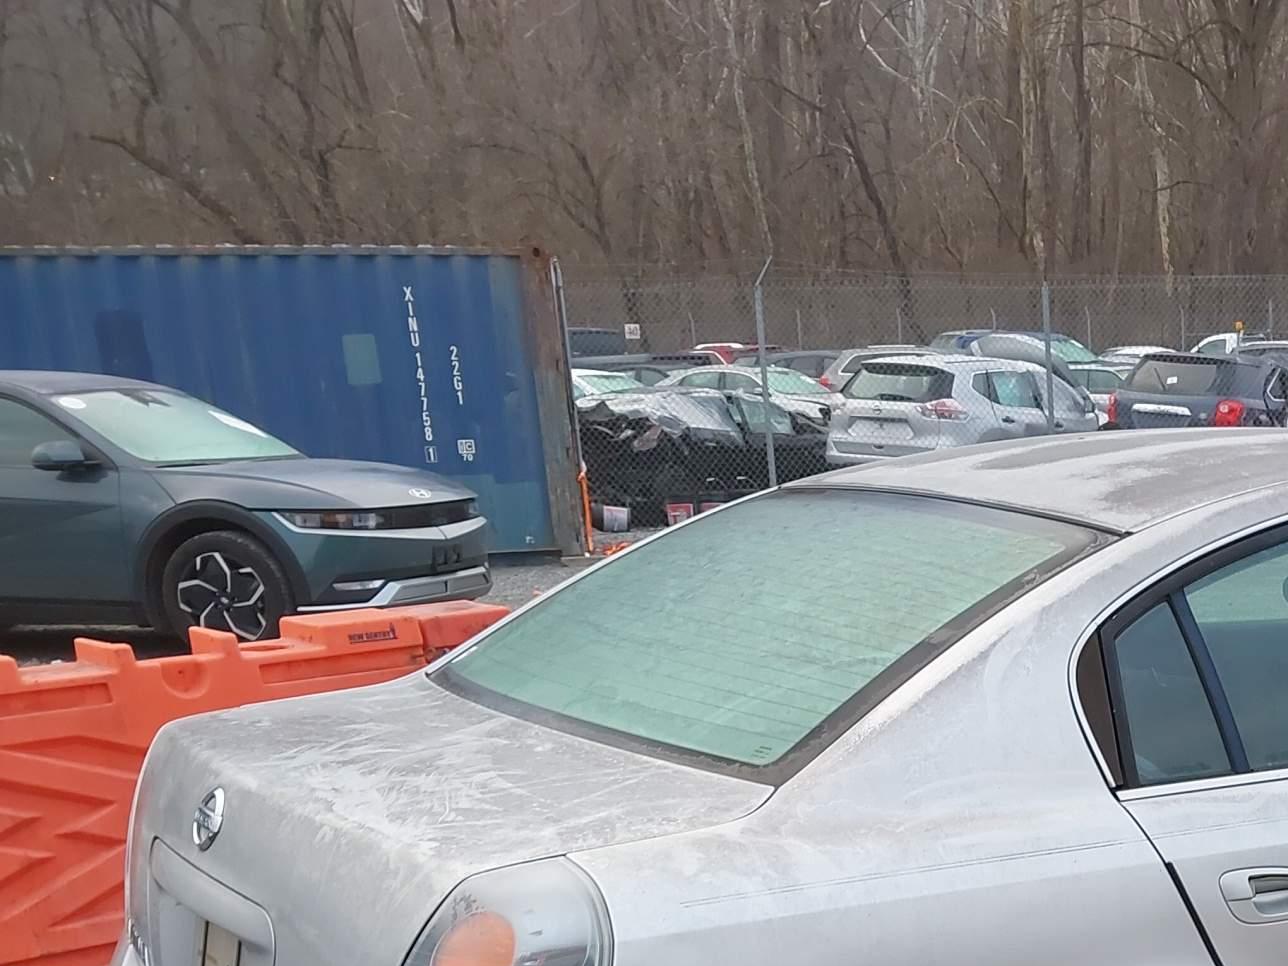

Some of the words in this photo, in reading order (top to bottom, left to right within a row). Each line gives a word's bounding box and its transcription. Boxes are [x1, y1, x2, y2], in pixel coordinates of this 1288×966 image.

[403, 286, 420, 347] XINU
[415, 352, 433, 442] 147758
[450, 345, 463, 405] 22G1
